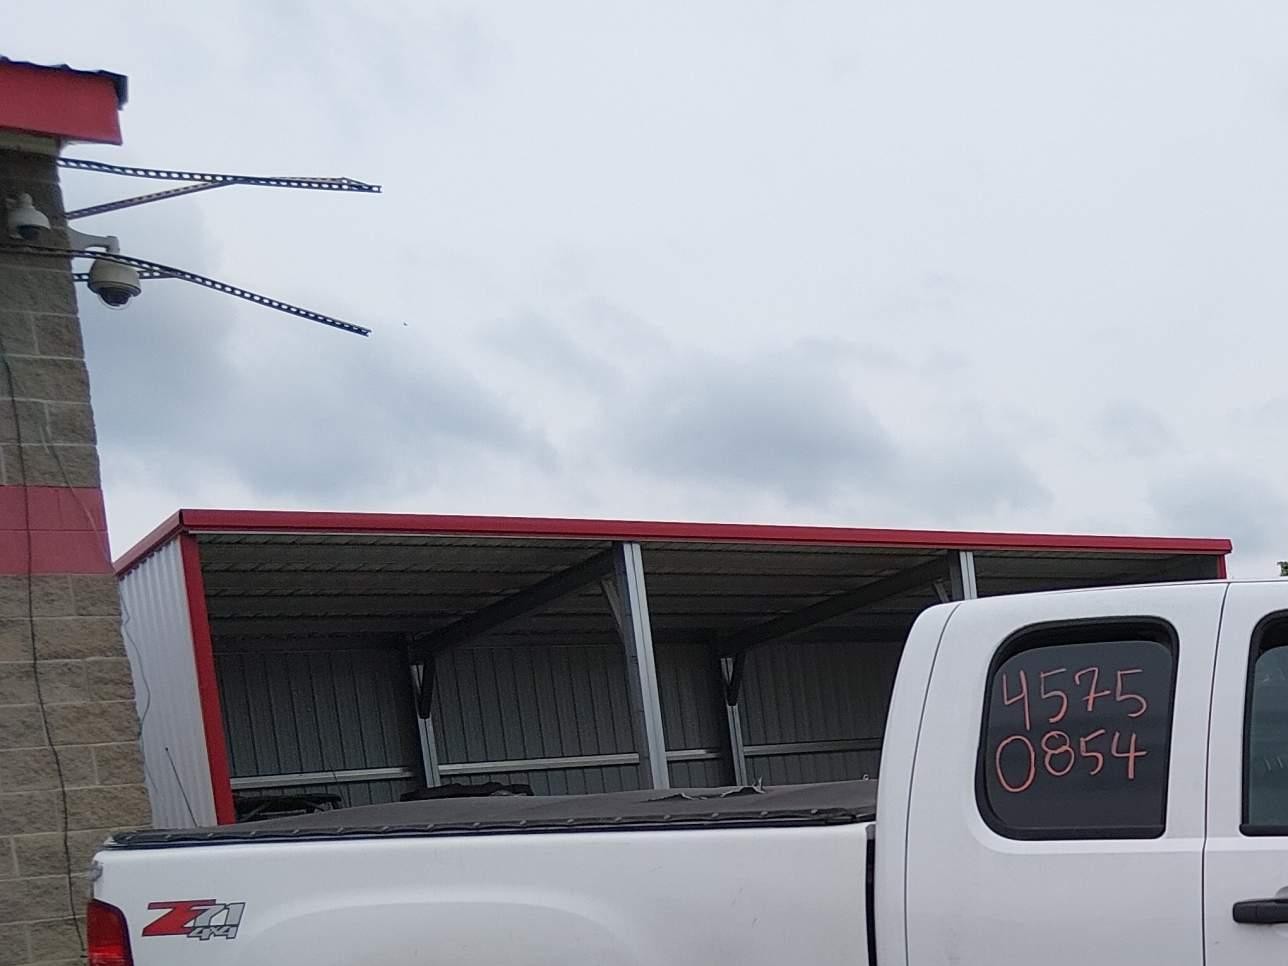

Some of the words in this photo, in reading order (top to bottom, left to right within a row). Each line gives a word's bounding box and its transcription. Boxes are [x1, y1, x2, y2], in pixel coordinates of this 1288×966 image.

[1002, 667, 1147, 730] 4575
[996, 730, 1148, 792] 0854
[142, 899, 246, 937] Z71
